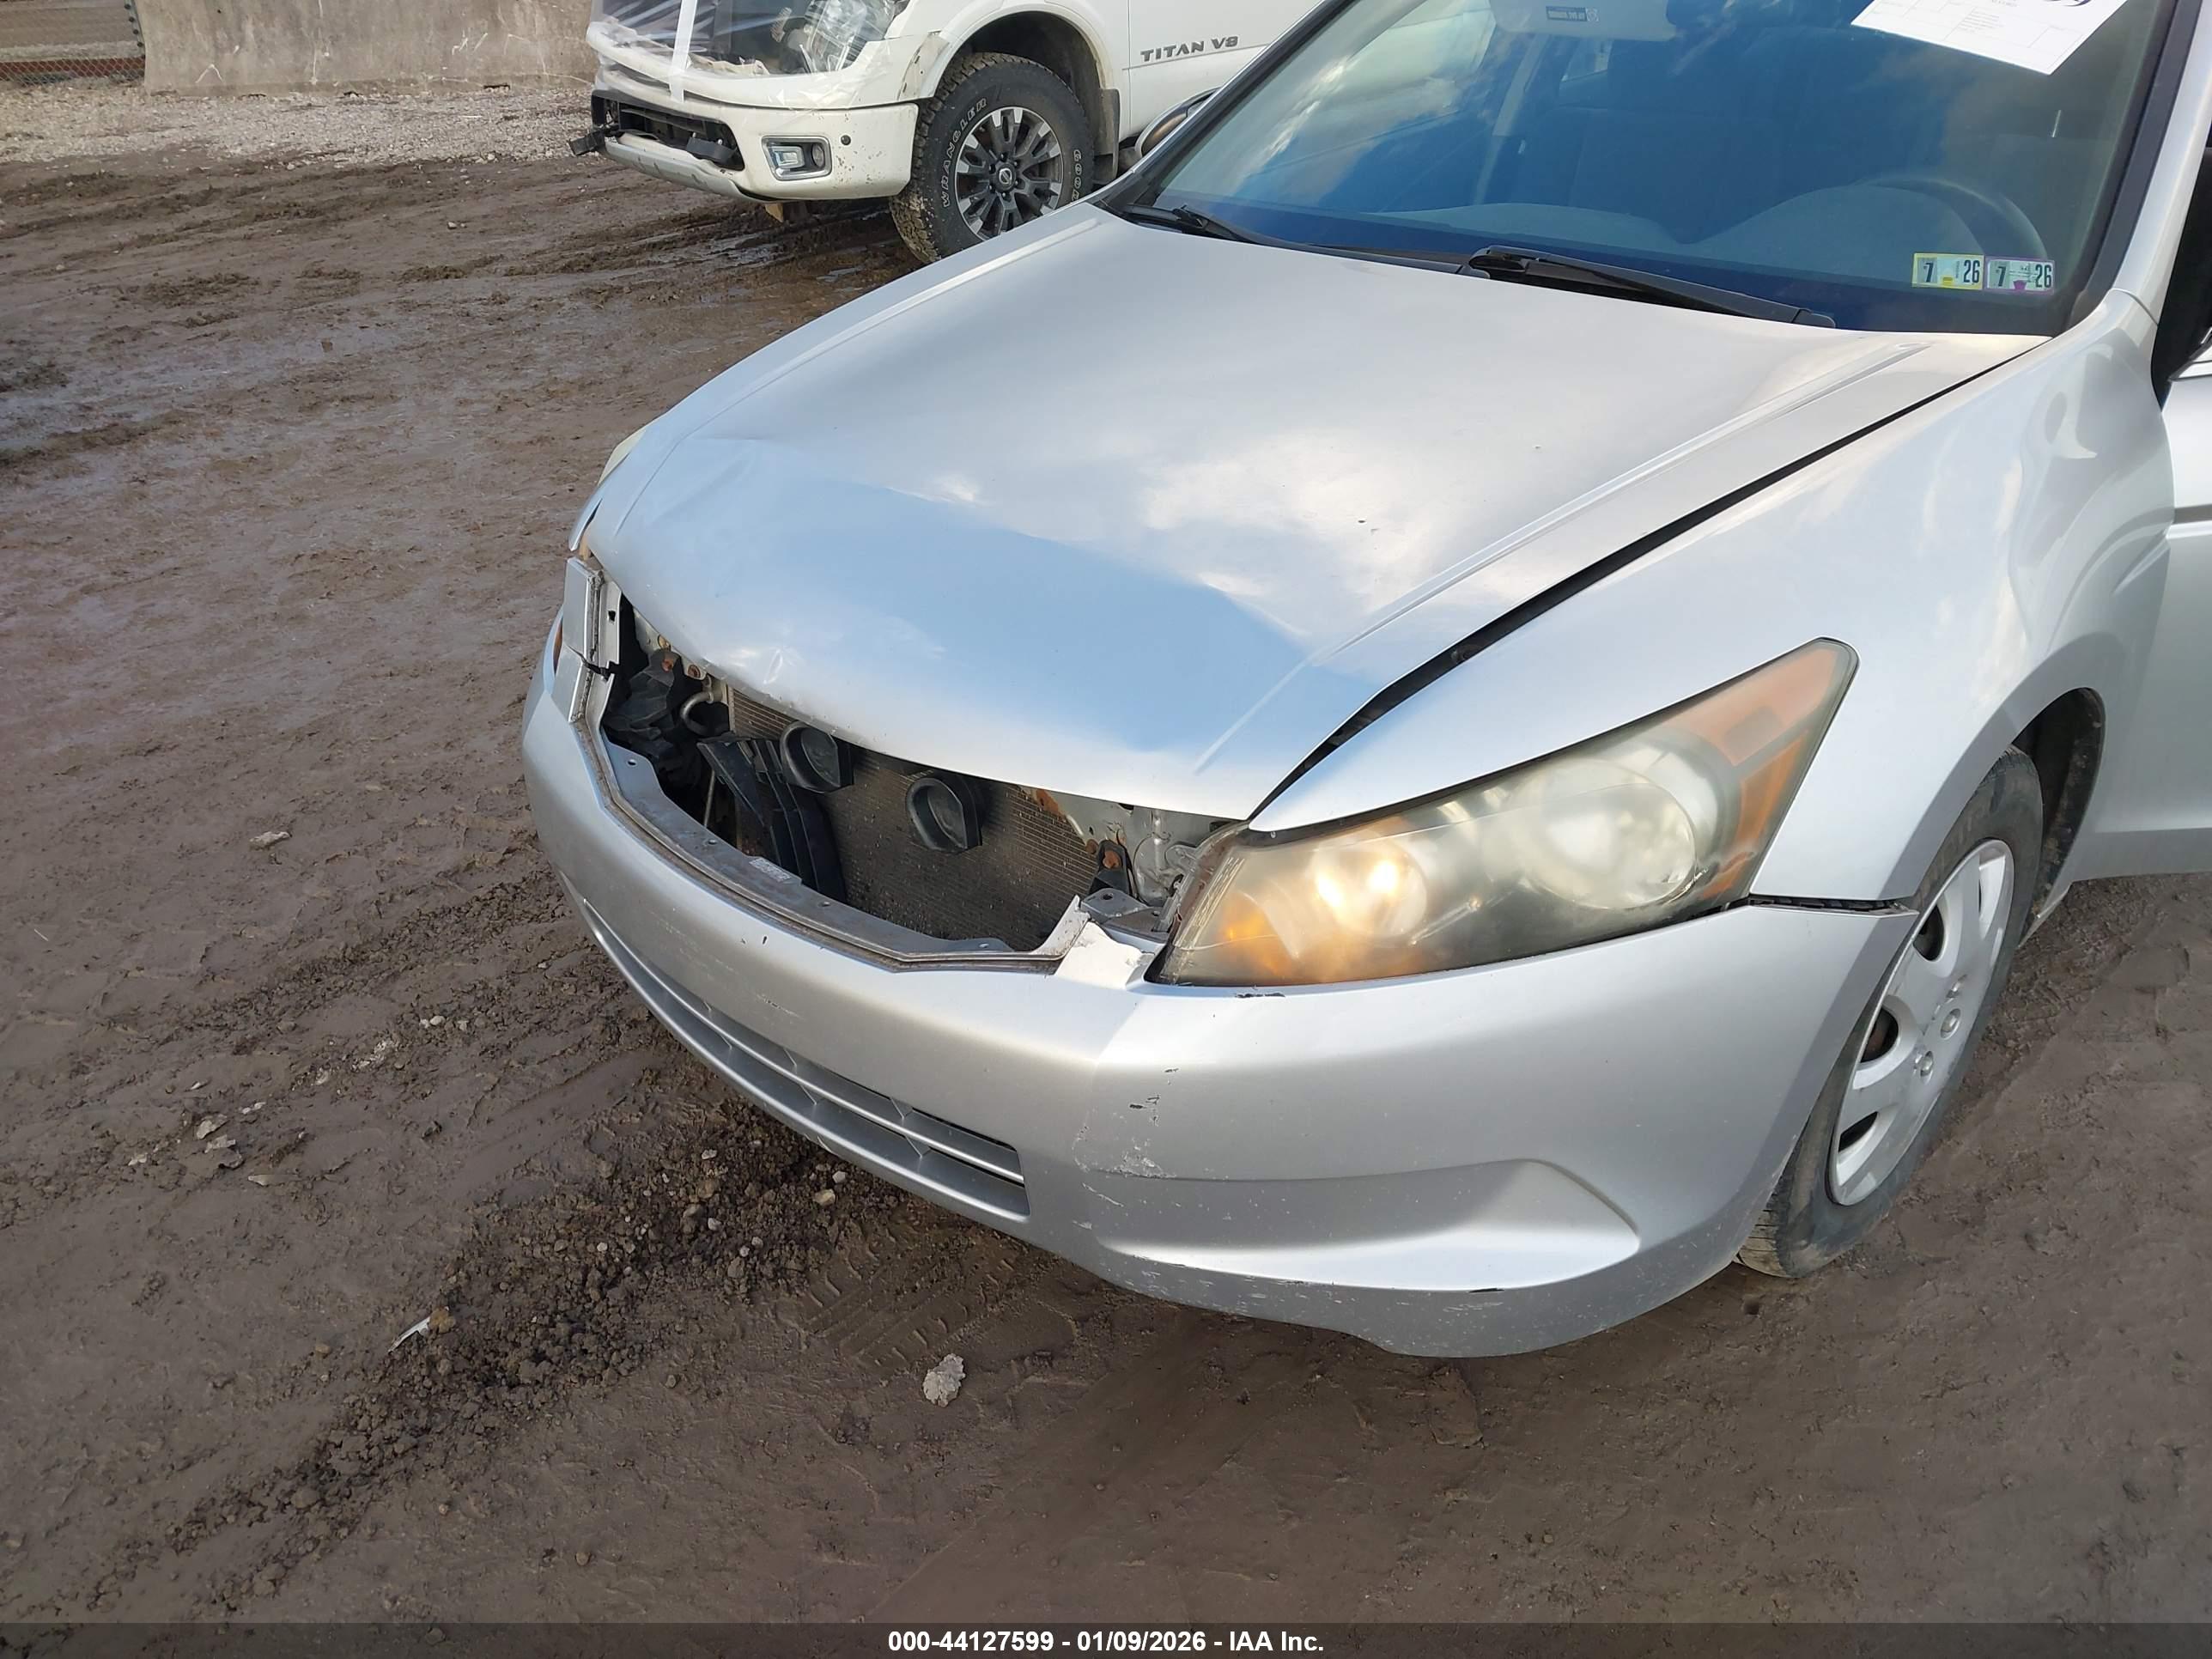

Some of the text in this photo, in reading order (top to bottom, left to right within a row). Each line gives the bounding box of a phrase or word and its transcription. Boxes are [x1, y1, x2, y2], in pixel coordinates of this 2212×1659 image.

[1140, 36, 1238, 62] TITAN V8
[941, 99, 987, 207] WRANGLER
[1924, 262, 1934, 283] 7
[1963, 259, 1981, 283] 26
[1996, 265, 2007, 287] 7
[2035, 264, 2052, 289] 26
